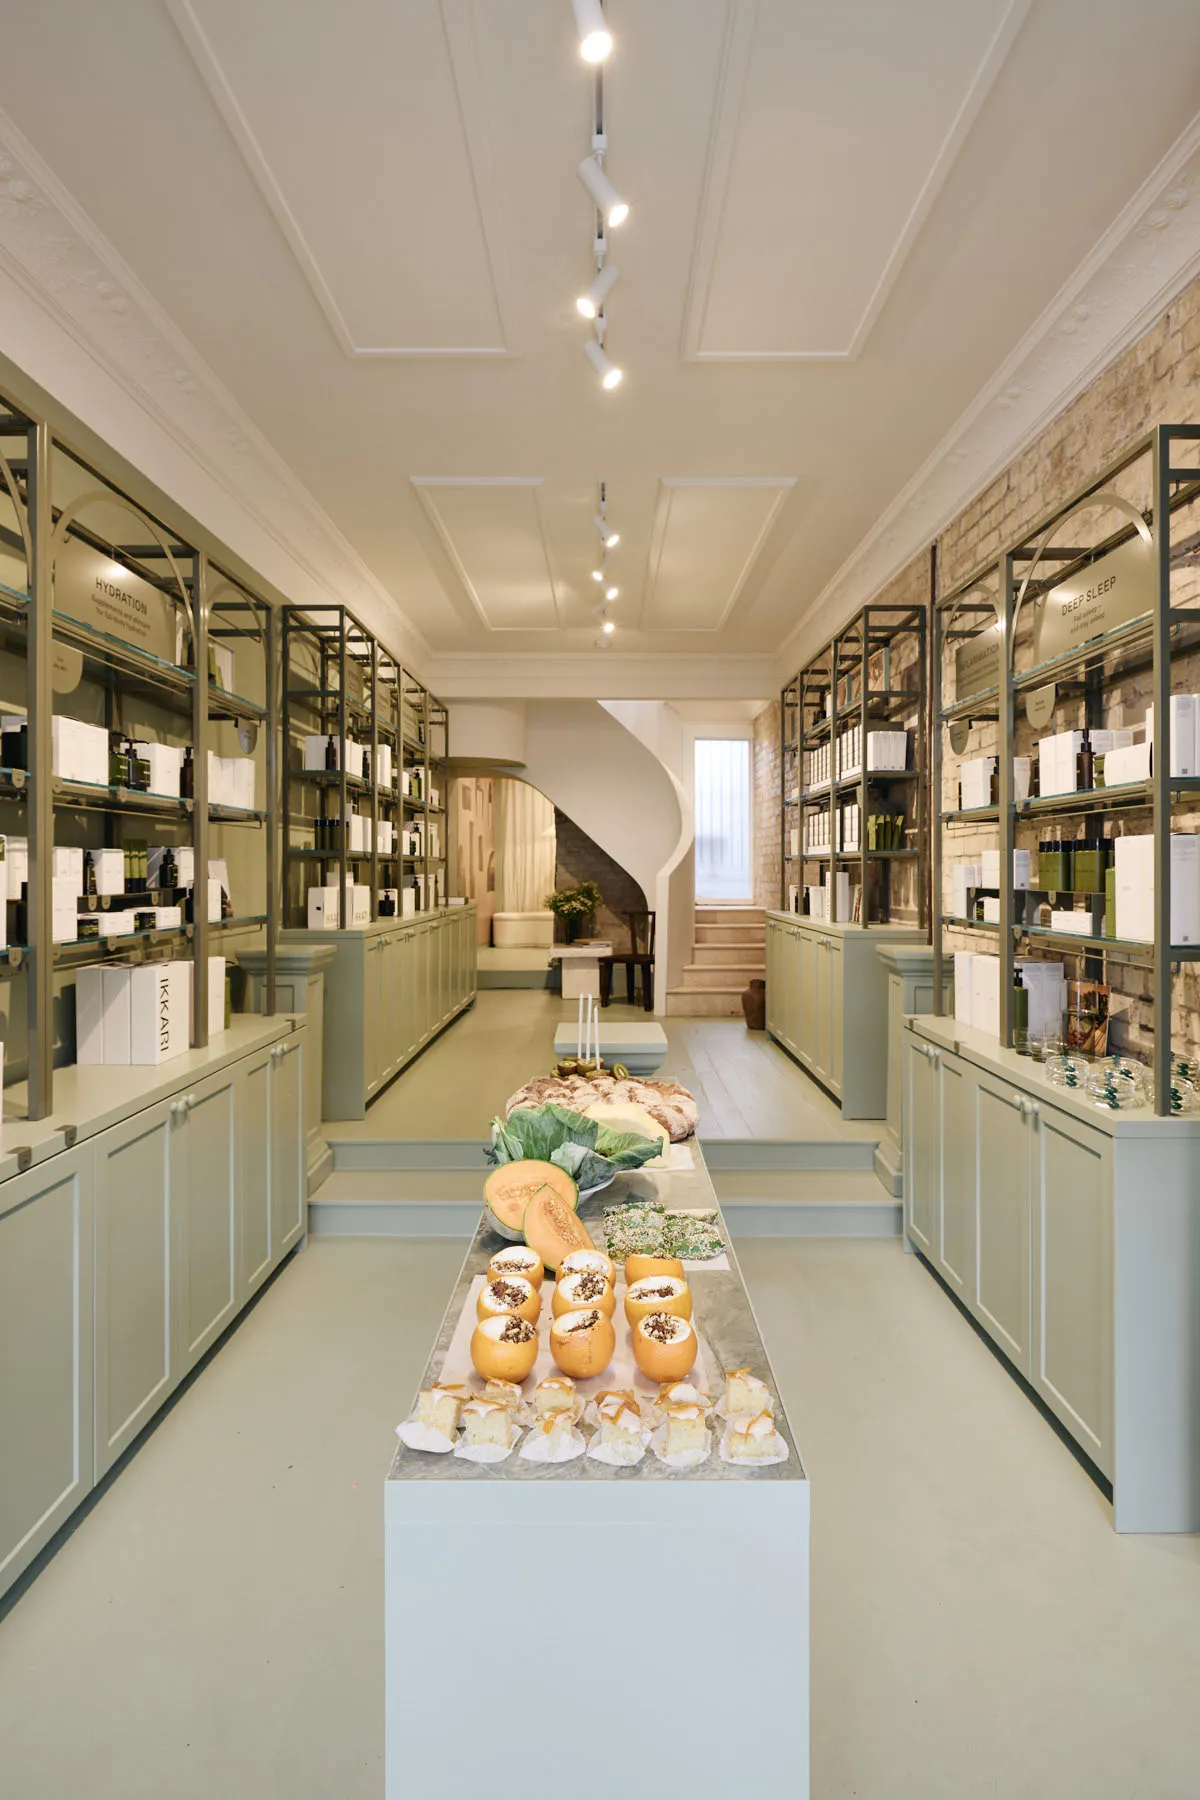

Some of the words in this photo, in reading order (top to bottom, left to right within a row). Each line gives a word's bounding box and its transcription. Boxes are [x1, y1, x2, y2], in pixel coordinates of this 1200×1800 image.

[95, 577, 147, 616] HYDRATION
[1062, 594, 1085, 616] DEEP
[1086, 575, 1116, 602] SLEEP
[160, 978, 169, 1052] IKKARI
